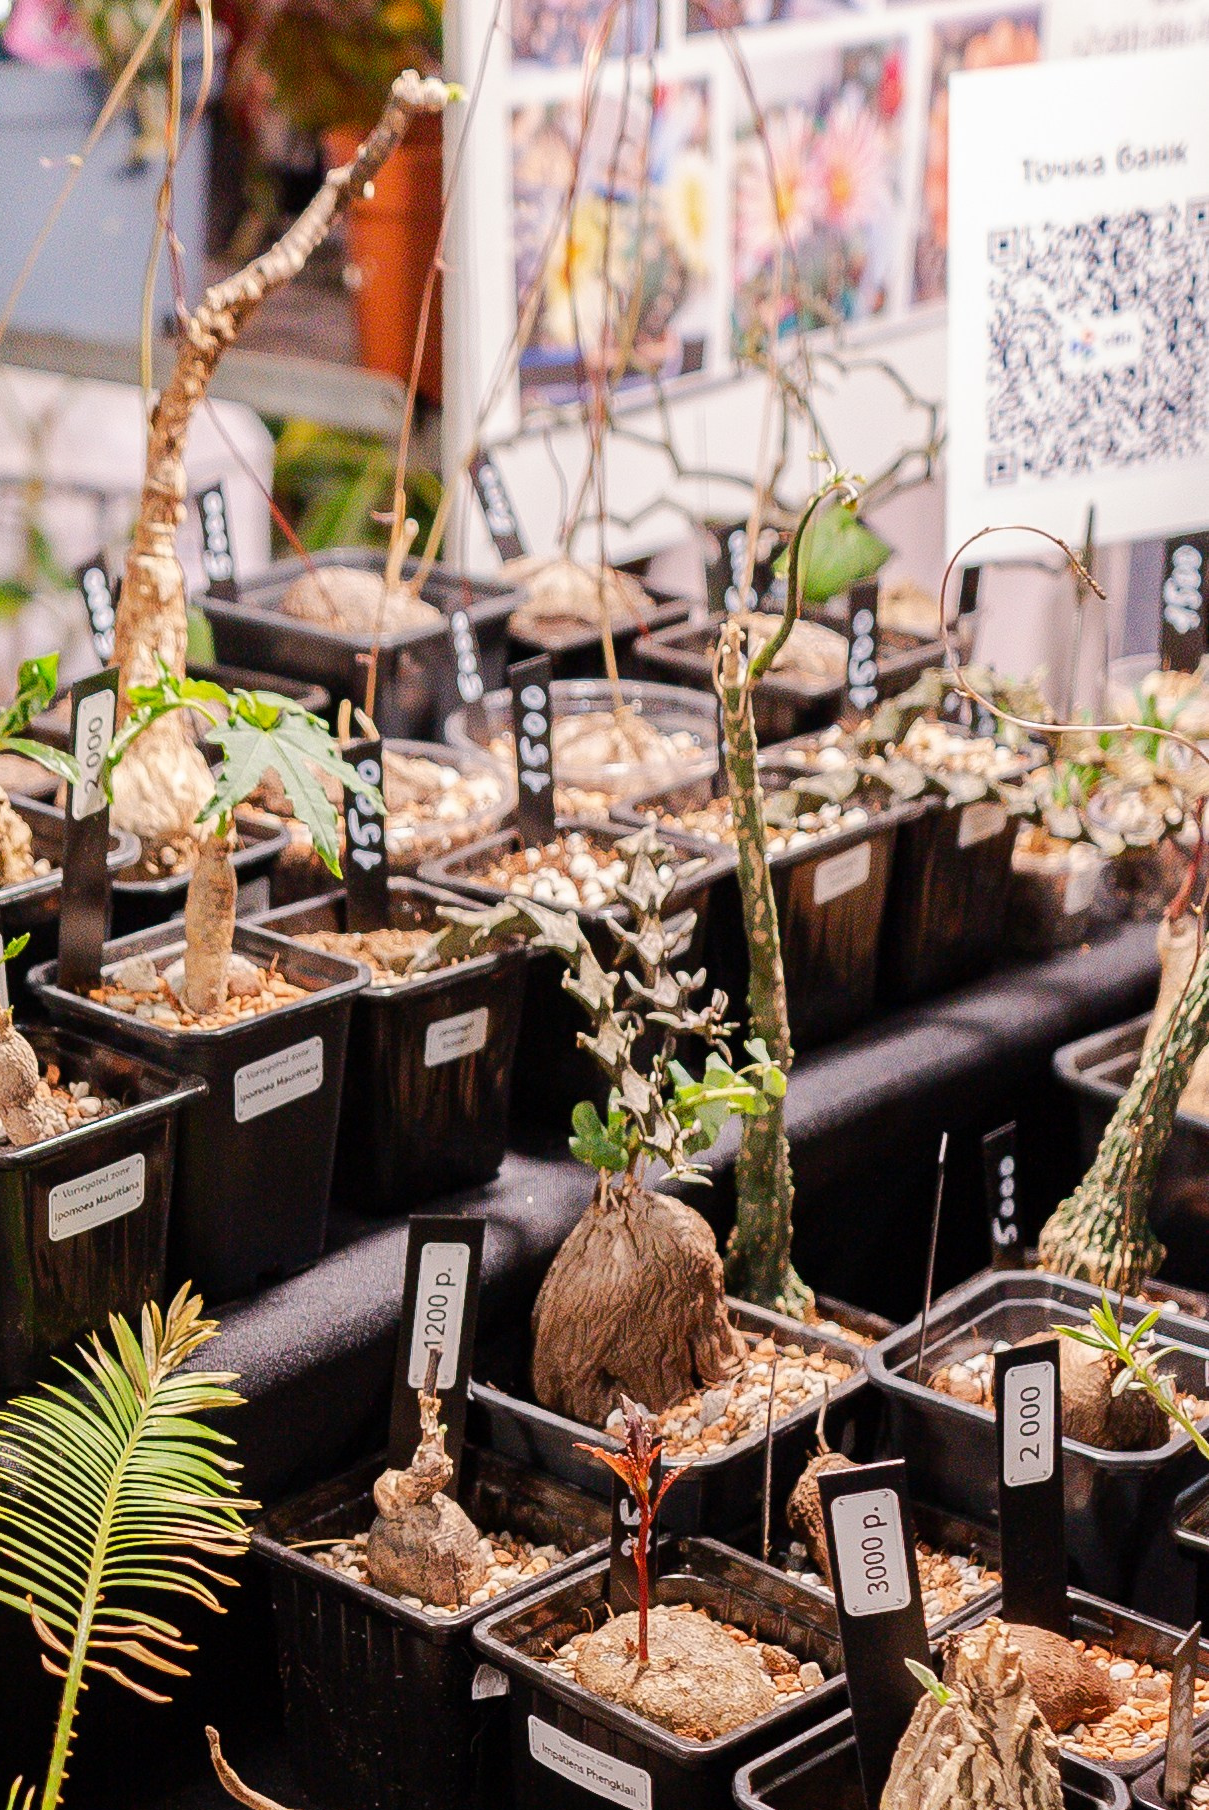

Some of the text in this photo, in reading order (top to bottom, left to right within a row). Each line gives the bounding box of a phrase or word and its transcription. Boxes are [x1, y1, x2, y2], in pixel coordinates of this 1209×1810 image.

[1021, 142, 1188, 185] Точка банк
[848, 608, 878, 710] 1500
[85, 716, 104, 769] 000
[520, 684, 551, 793] 1500
[347, 759, 382, 871] 1500
[53, 1180, 140, 1224] Ipomoea Mauritiana
[61, 1166, 131, 1199] Variegated zone
[993, 1155, 1018, 1245] 5000
[425, 1292, 450, 1350] 1200
[1019, 1385, 1042, 1464] 2 000
[862, 1535, 890, 1597] 3000
[541, 1742, 586, 1776] Impatiens
